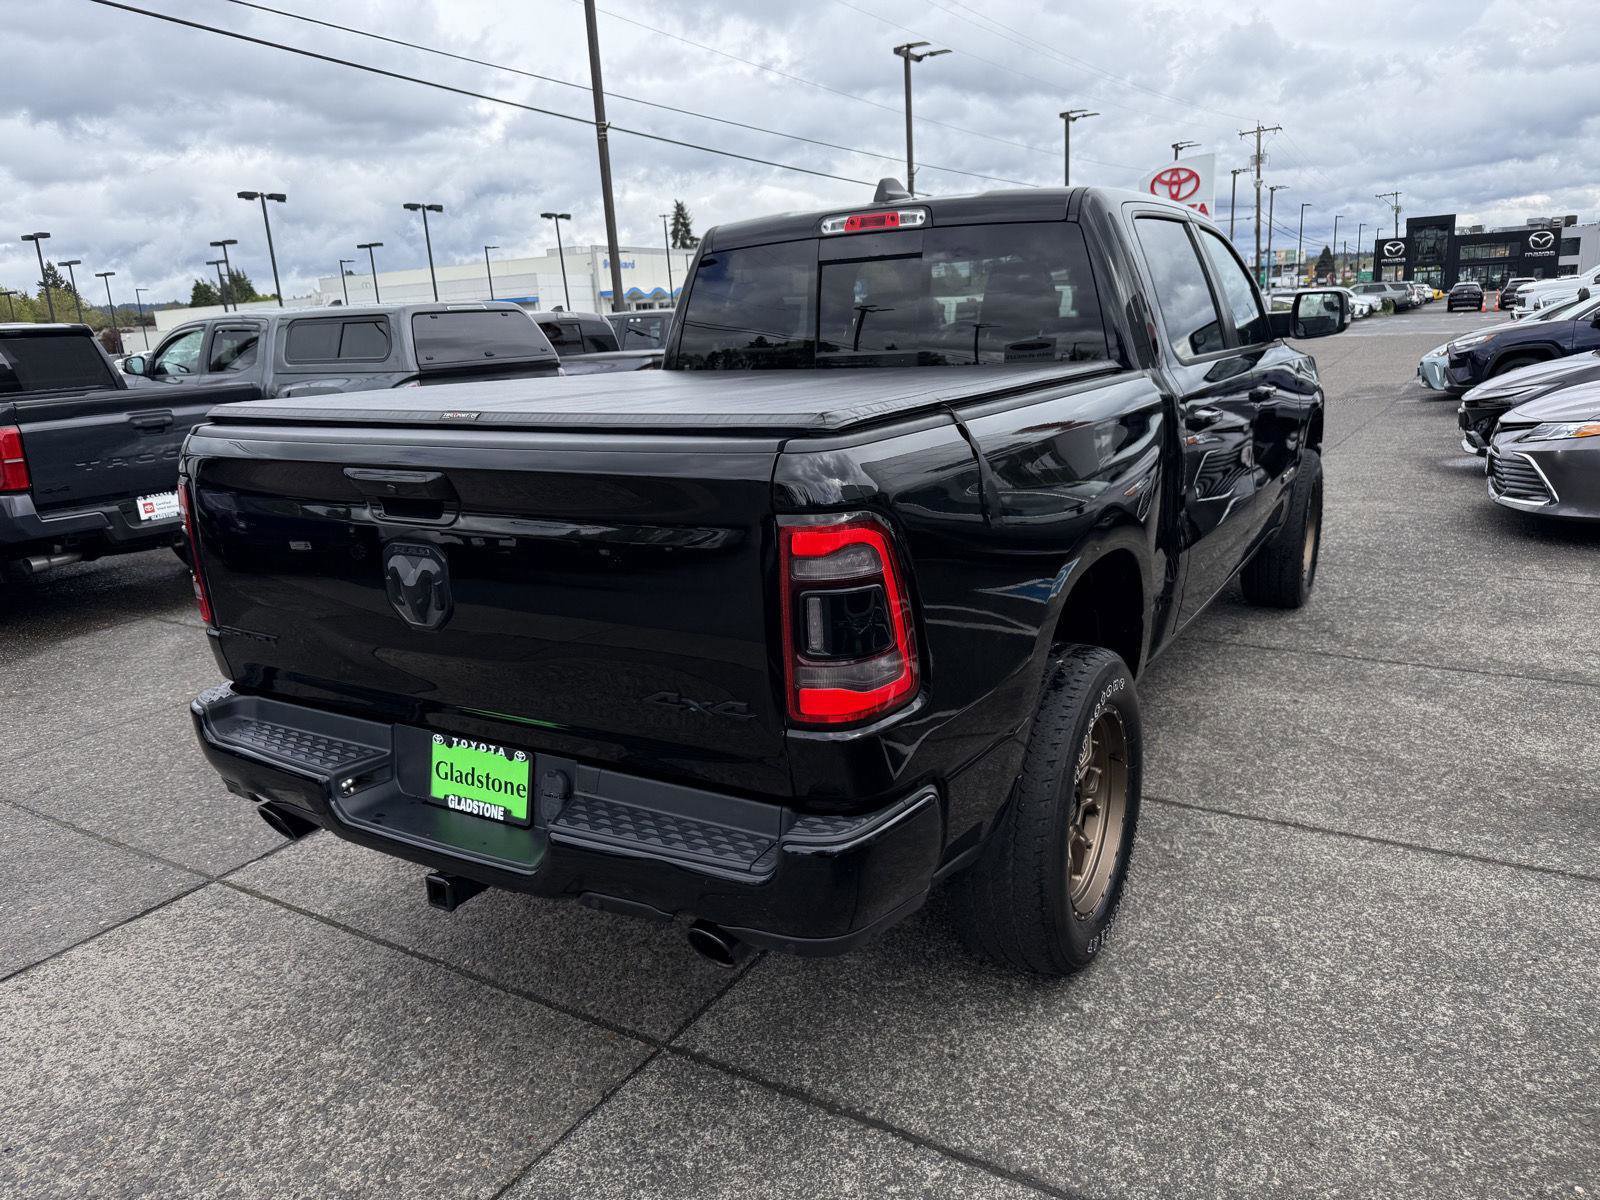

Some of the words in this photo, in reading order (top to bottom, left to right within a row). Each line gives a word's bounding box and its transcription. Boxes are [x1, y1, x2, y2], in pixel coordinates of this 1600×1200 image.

[75, 451, 179, 471] TACO
[451, 737, 506, 757] TOYOTA
[435, 760, 527, 798] Gladstone
[447, 794, 505, 821] GLADSTONE
